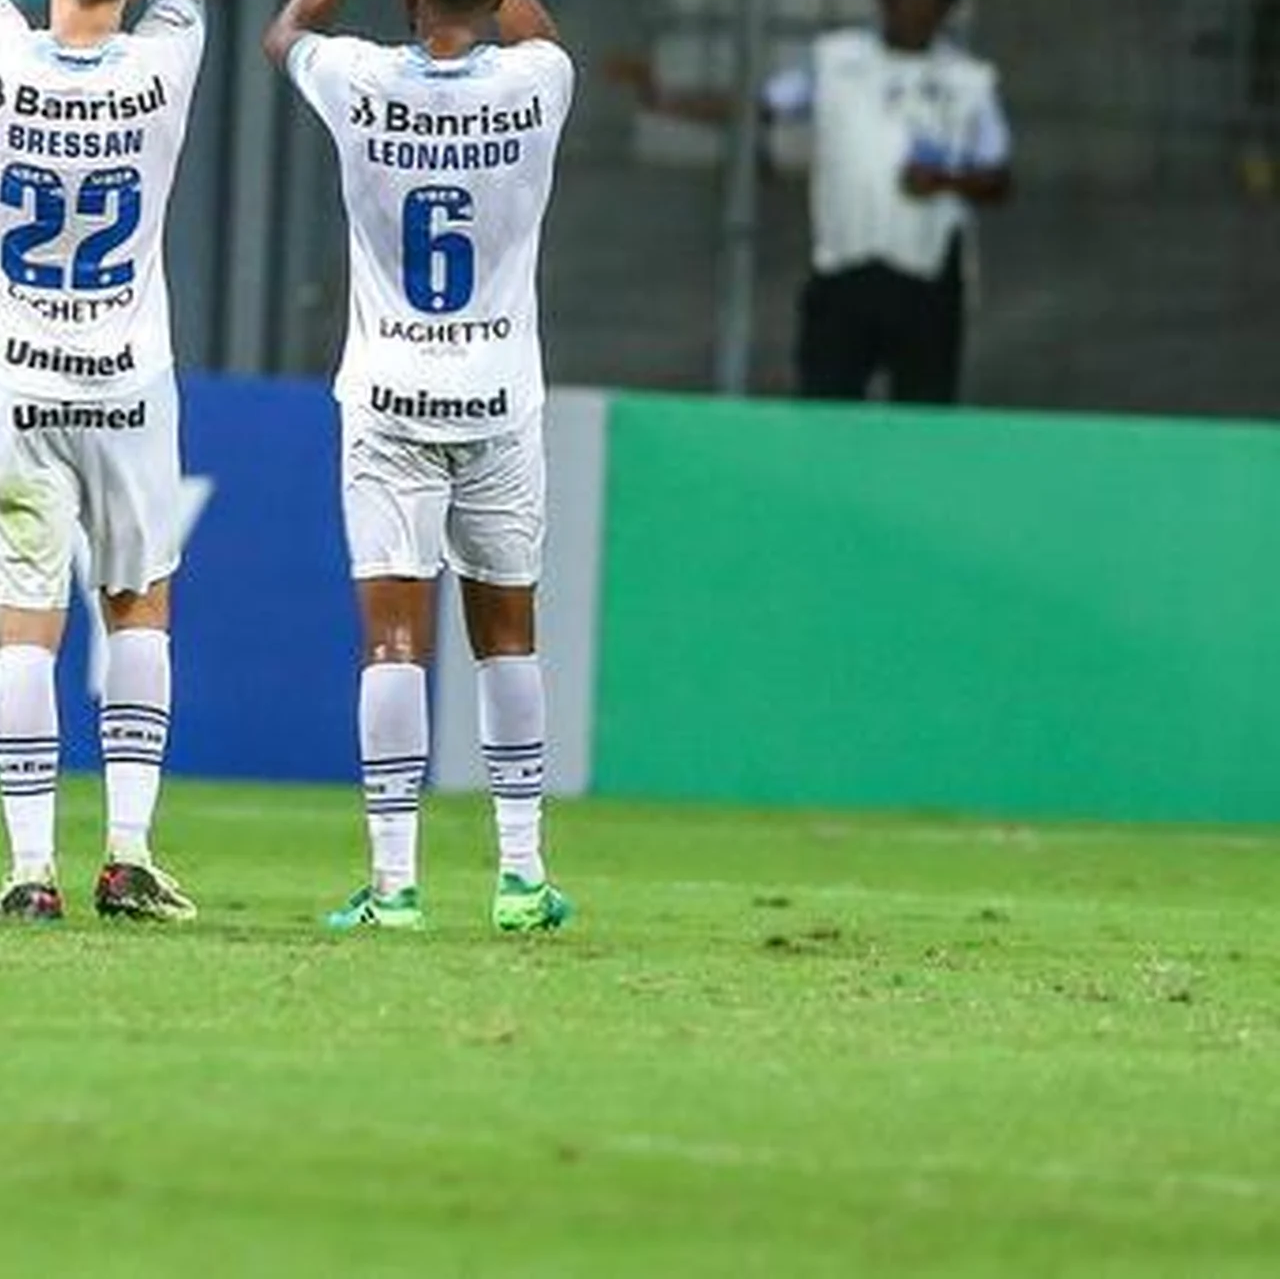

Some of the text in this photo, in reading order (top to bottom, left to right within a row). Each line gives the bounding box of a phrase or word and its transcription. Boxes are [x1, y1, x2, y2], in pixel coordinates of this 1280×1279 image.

[13, 75, 168, 122] Banrisul
[385, 96, 543, 137] Banrisul
[7, 124, 144, 159] BRESSAN
[367, 138, 521, 170] LEONARDO
[402, 185, 475, 314] 6
[379, 318, 512, 345] LAGHETTO
[5, 337, 136, 378] Unimed
[12, 399, 146, 432] Unimed
[370, 386, 508, 420] Unimed
